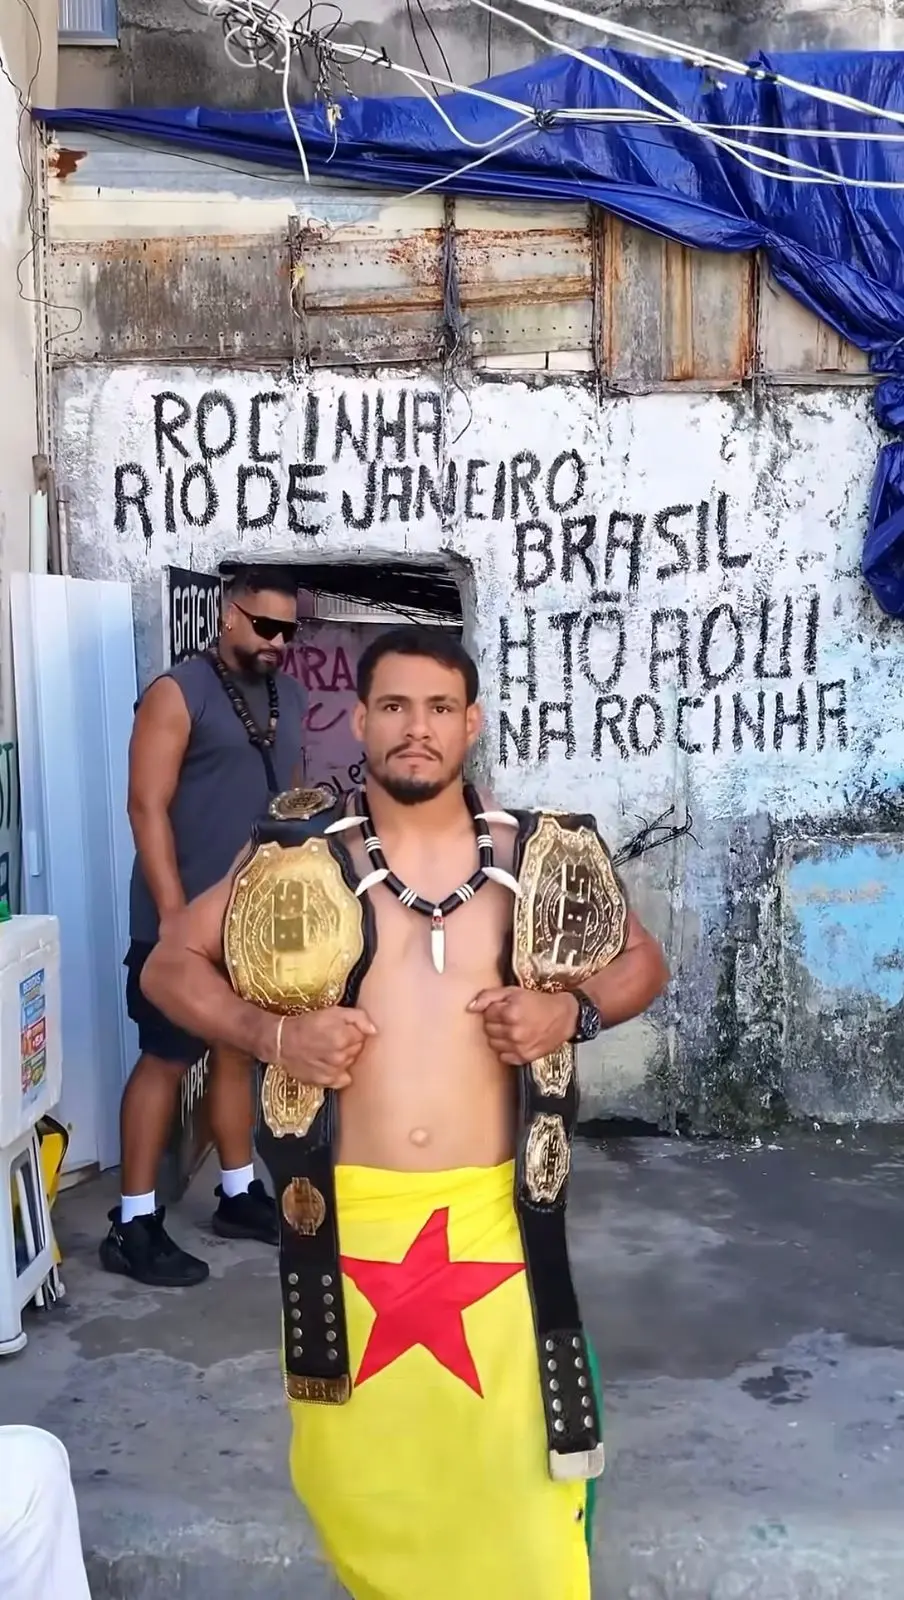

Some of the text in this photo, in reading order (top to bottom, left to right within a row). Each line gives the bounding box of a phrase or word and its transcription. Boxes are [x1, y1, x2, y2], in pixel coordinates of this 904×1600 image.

[152, 389, 442, 471] ROCINHA
[114, 448, 588, 538] RIO DE JANEIRO
[513, 491, 753, 590] BRASIL
[499, 680, 848, 767] NA ROCINHA
